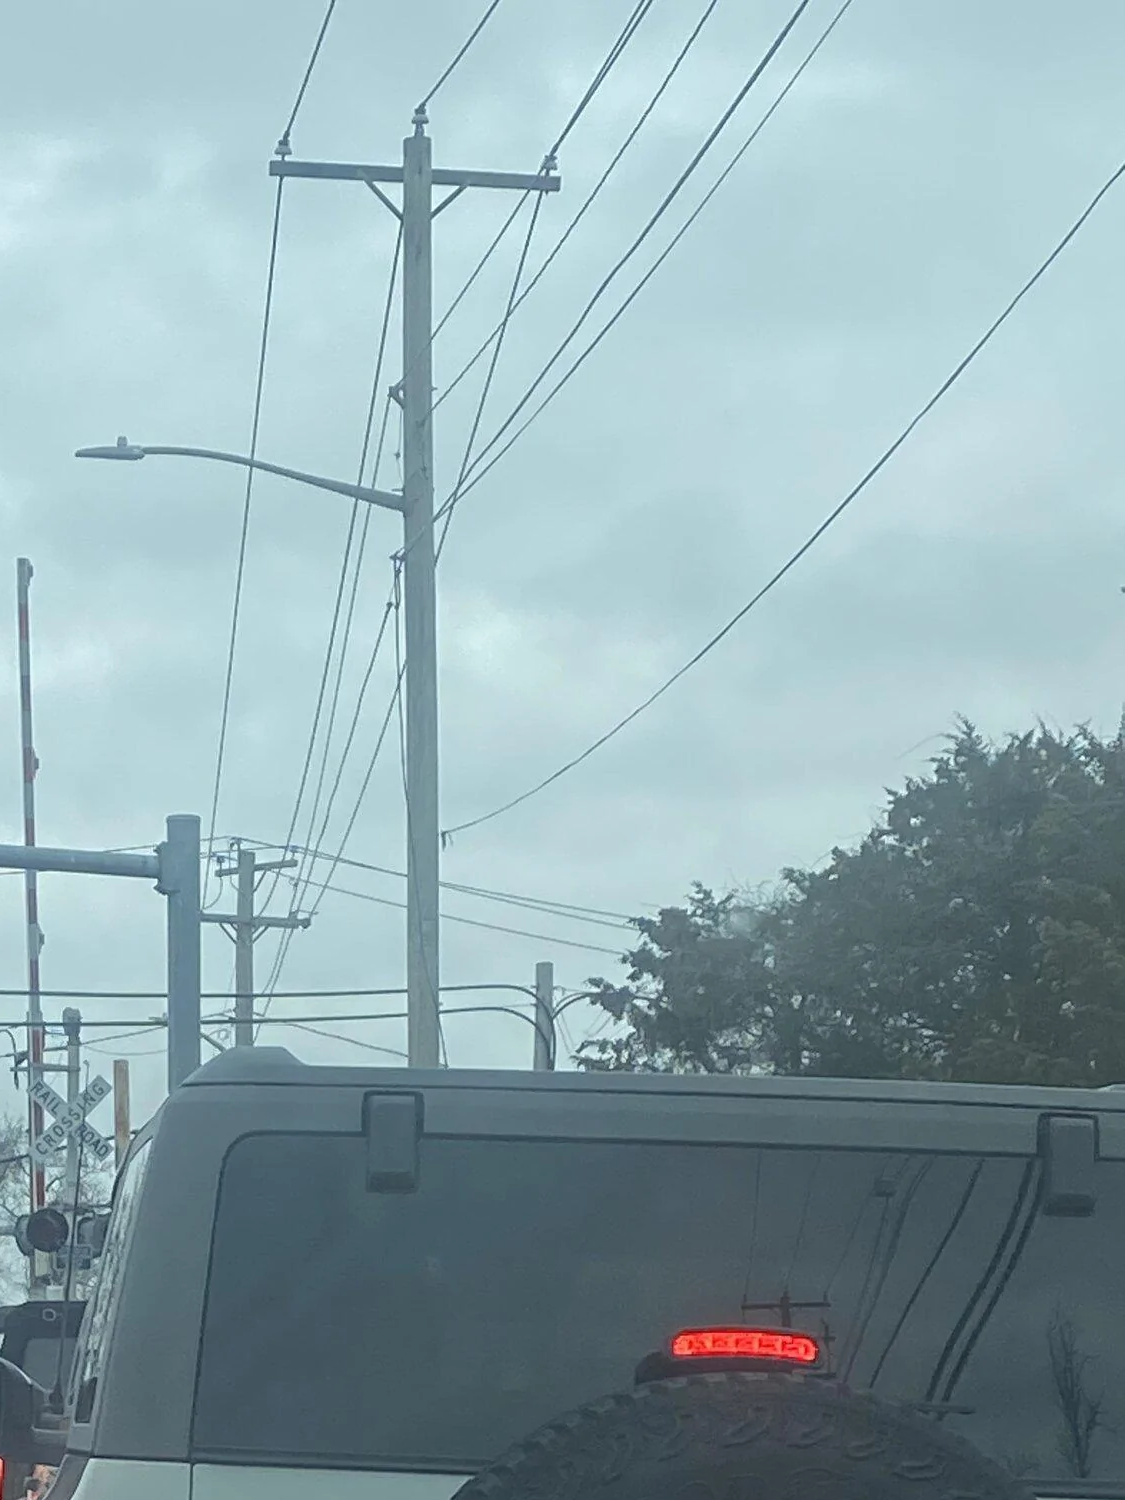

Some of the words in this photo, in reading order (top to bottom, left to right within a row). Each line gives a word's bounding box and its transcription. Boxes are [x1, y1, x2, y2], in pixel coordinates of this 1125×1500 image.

[30, 1081, 60, 1116] RAIL
[74, 1122, 109, 1157] ROAD
[35, 1083, 105, 1155] CROSSING
